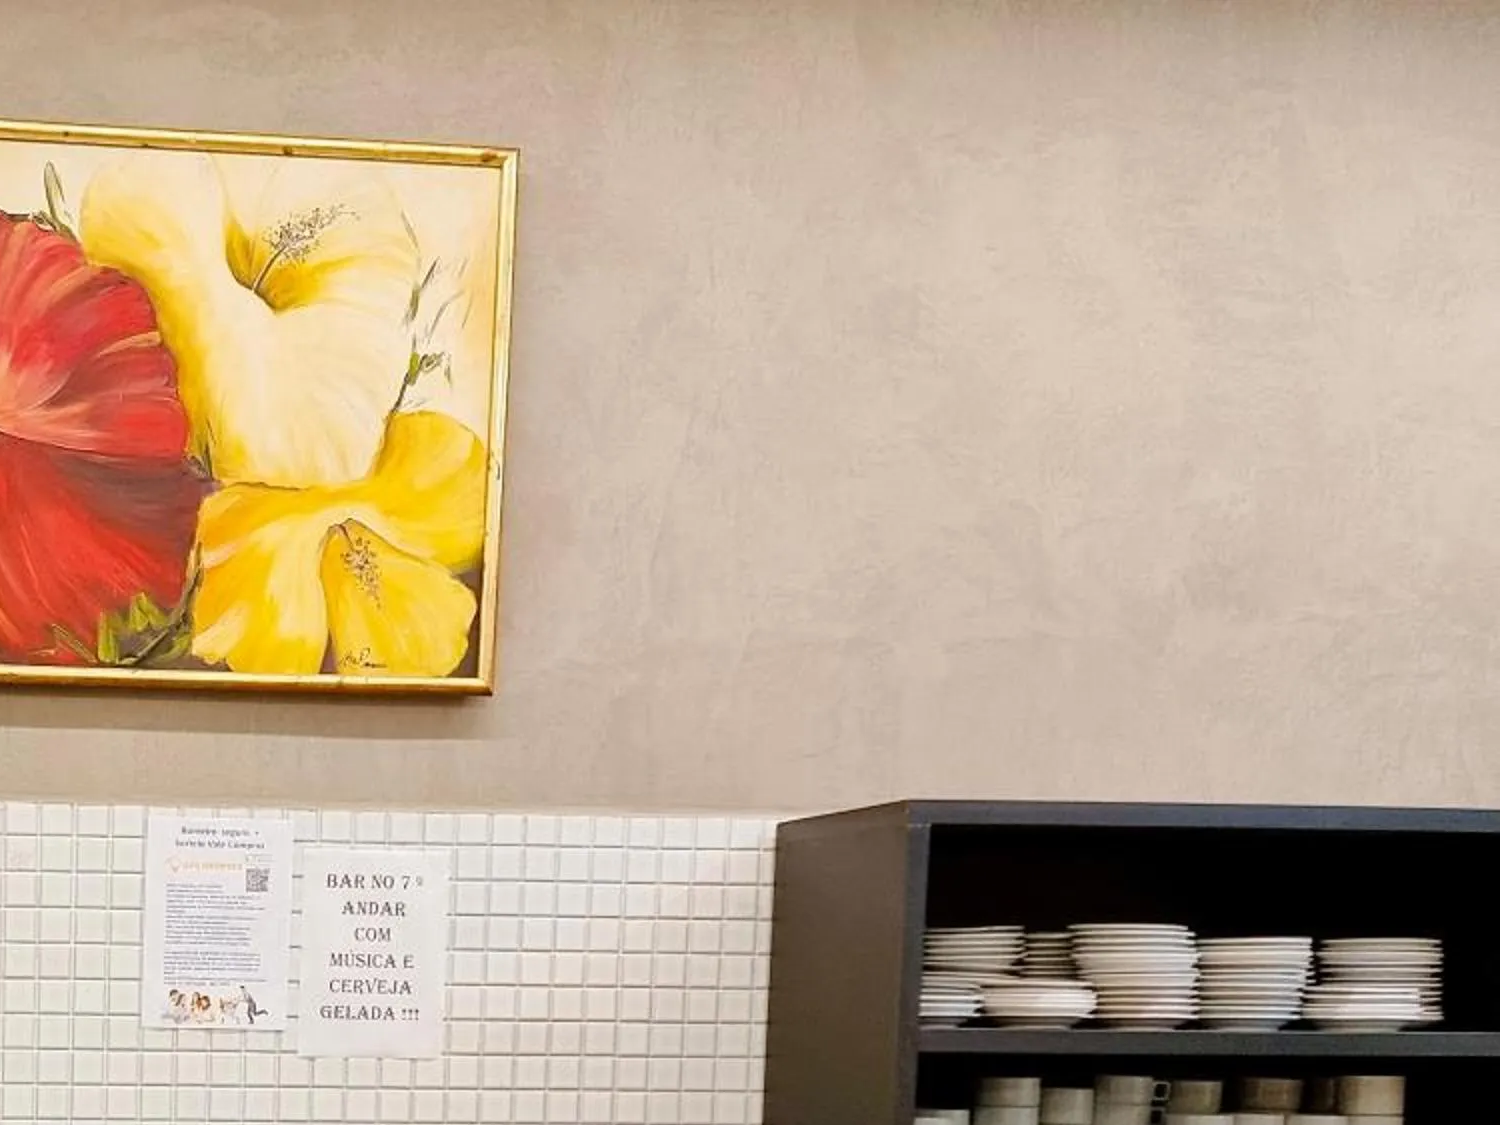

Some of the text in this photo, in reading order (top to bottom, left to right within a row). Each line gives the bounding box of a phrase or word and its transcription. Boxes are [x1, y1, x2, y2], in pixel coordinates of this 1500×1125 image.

[326, 873, 366, 889] BAR
[371, 873, 396, 889] NO
[341, 900, 406, 917] ANDAR
[353, 926, 392, 943] COM
[402, 954, 415, 969] E
[328, 978, 412, 995] CERVEJA
[319, 1004, 396, 1021] GELADA
